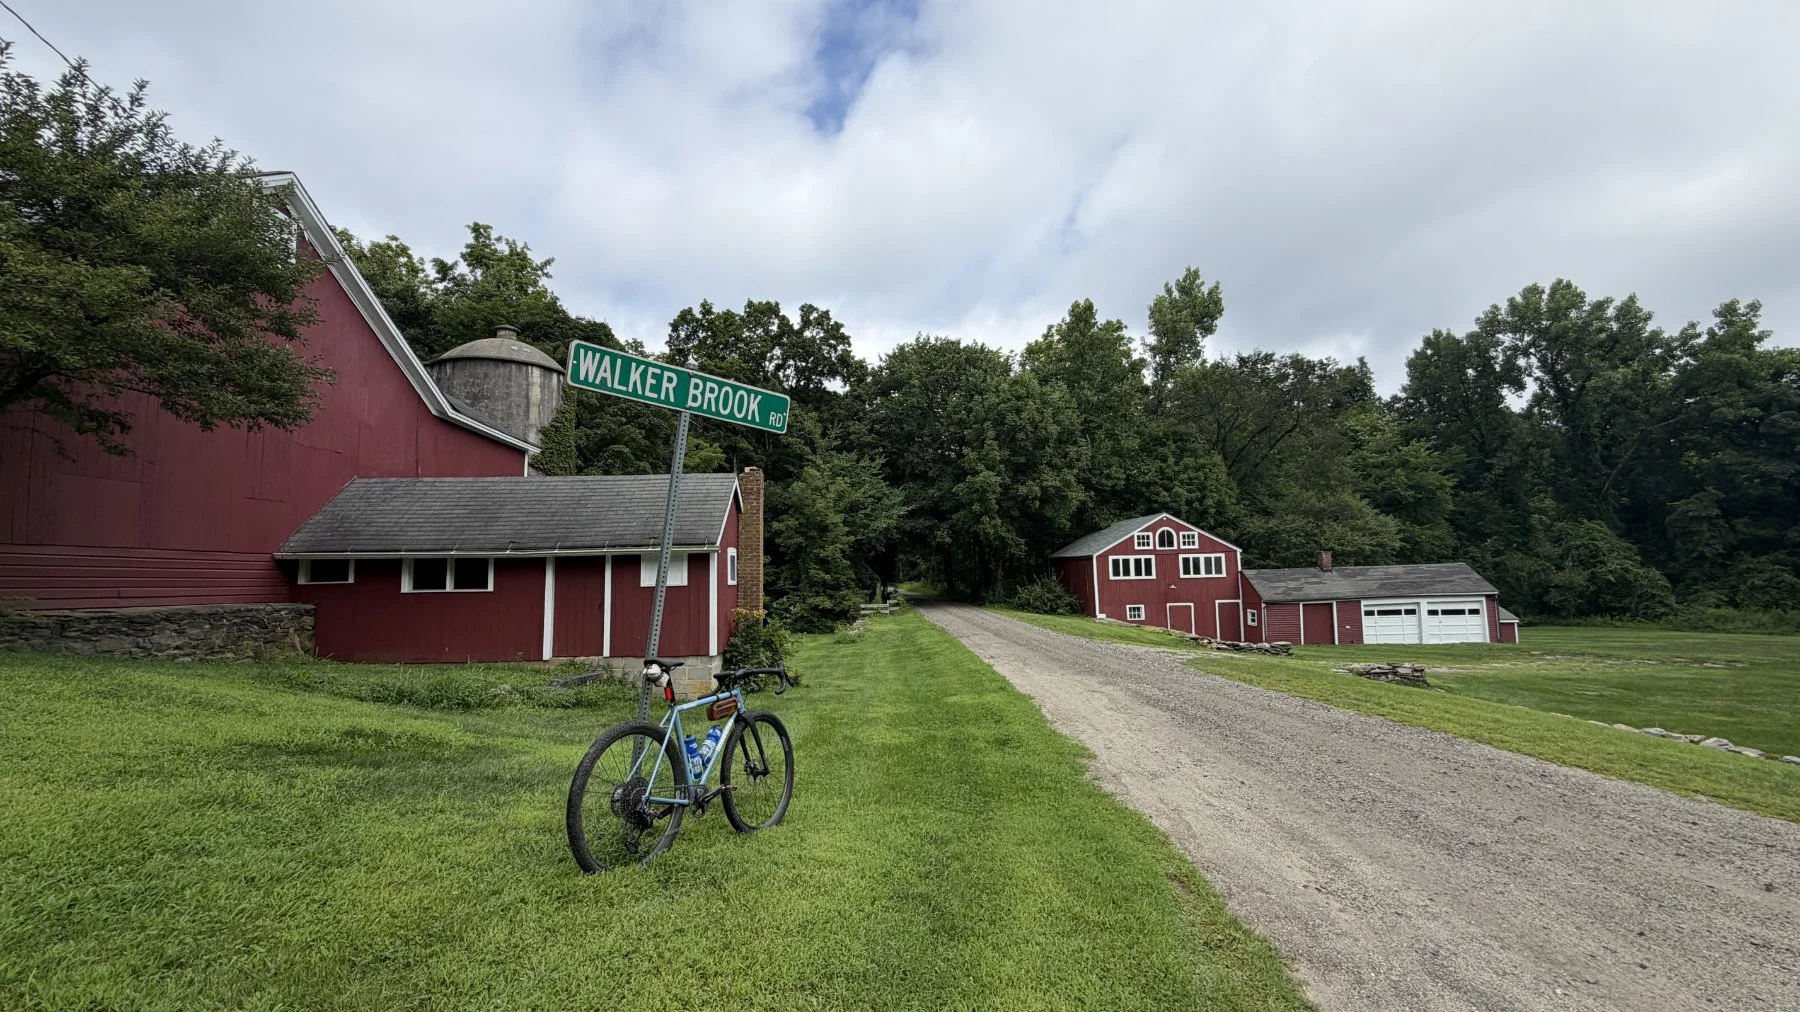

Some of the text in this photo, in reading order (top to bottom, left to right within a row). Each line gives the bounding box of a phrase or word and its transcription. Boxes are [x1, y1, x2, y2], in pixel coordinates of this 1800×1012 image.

[579, 348, 783, 427] WALKER BROOK RD
